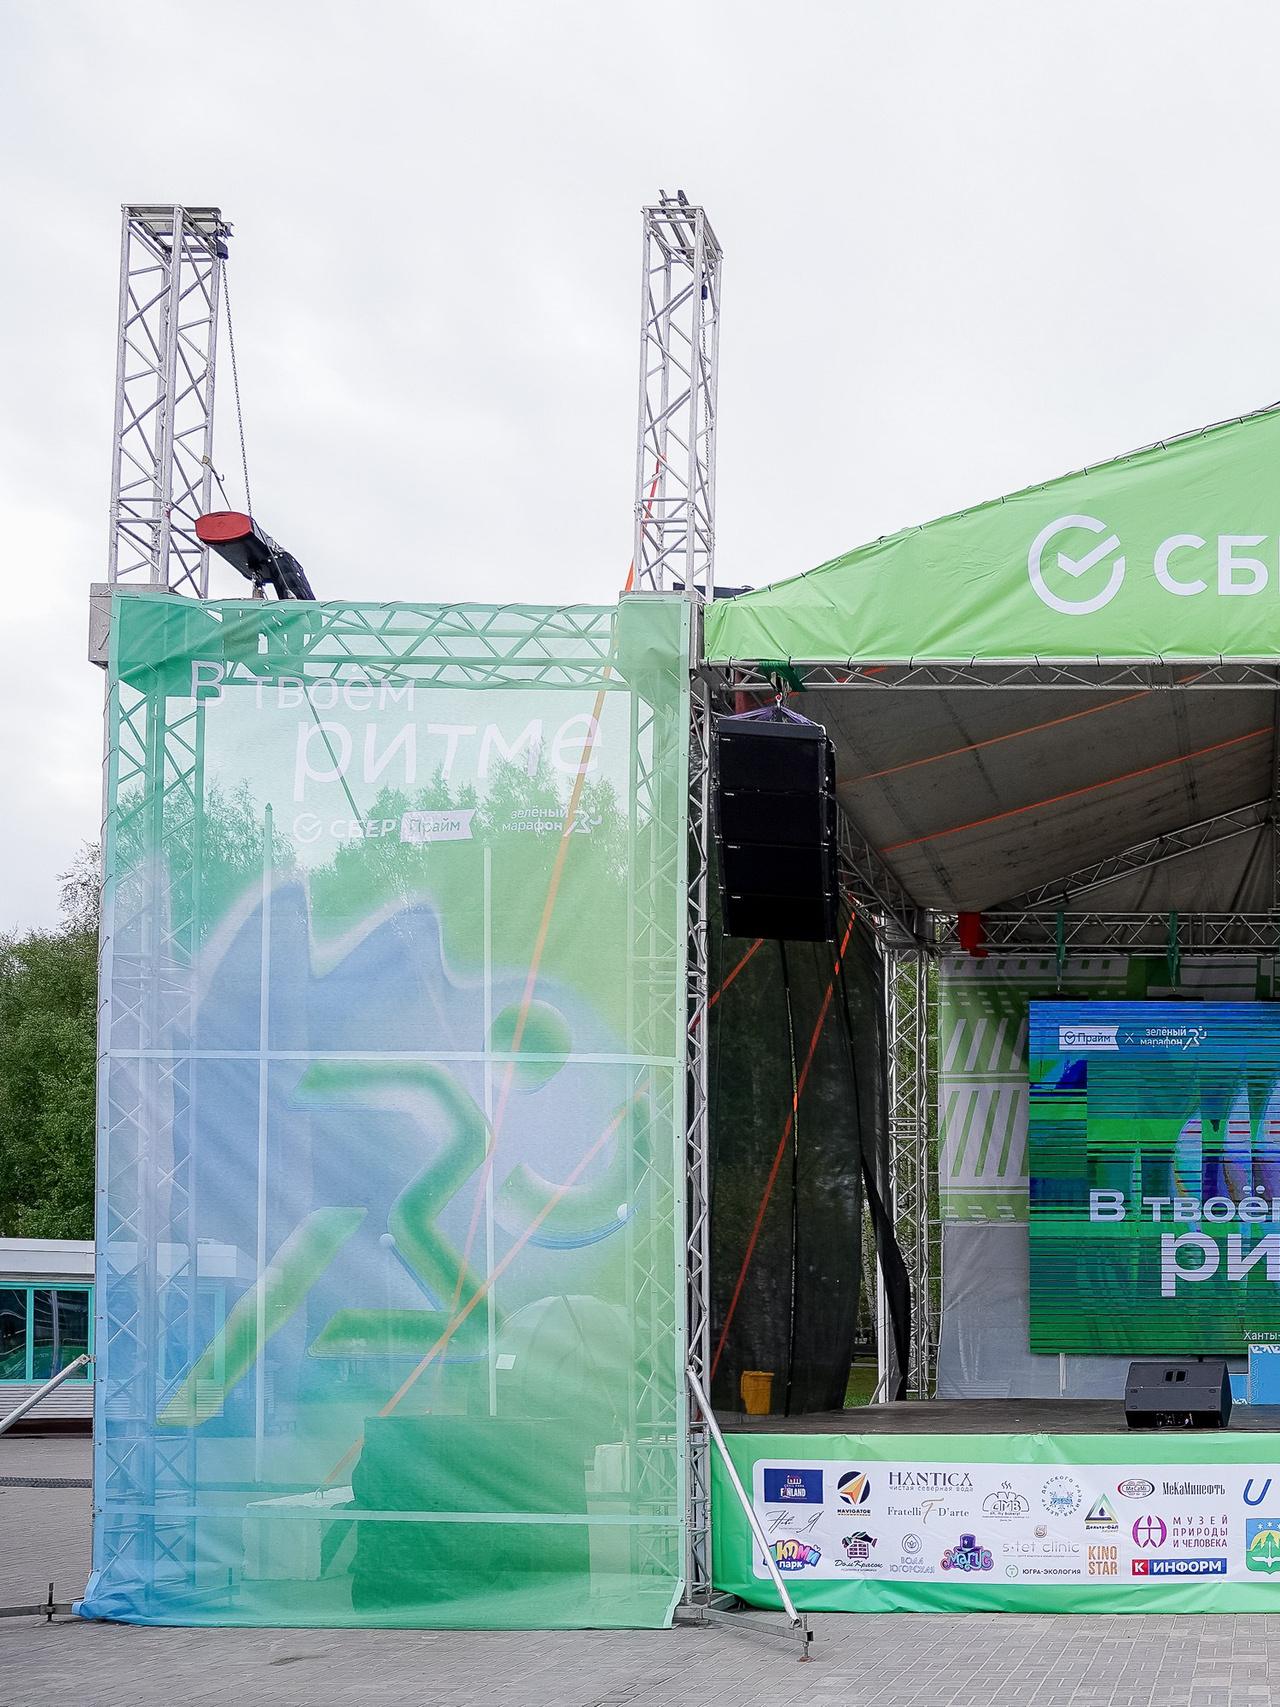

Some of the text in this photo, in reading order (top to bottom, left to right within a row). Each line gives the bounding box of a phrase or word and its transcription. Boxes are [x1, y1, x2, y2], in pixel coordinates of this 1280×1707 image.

[190, 660, 415, 712] В твоём
[294, 712, 603, 802] ритме
[510, 805, 570, 820] зелёный
[330, 817, 462, 840] СБЕР Прайм
[502, 819, 563, 834] марафон
[1077, 1031, 1111, 1045] Прайм
[1145, 1025, 1187, 1037] зелёный
[1140, 1038, 1183, 1049] марафон
[1089, 1188, 1126, 1223] В
[1162, 1481, 1226, 1496] МеКаМинефть
[886, 1506, 922, 1516] Fratelli
[938, 1507, 970, 1517] D'arte
[1172, 1514, 1228, 1525] МУЗЕЙ
[1172, 1527, 1228, 1537] ПРИРОДЫ
[1042, 1541, 1080, 1554] clinic
[1172, 1538, 1228, 1548] И ЧЕЛОВЕКА
[1088, 1545, 1118, 1560] KINO
[779, 1560, 803, 1571] парк
[1088, 1561, 1118, 1576] STAR
[1153, 1560, 1222, 1573] ИНФОРМ
